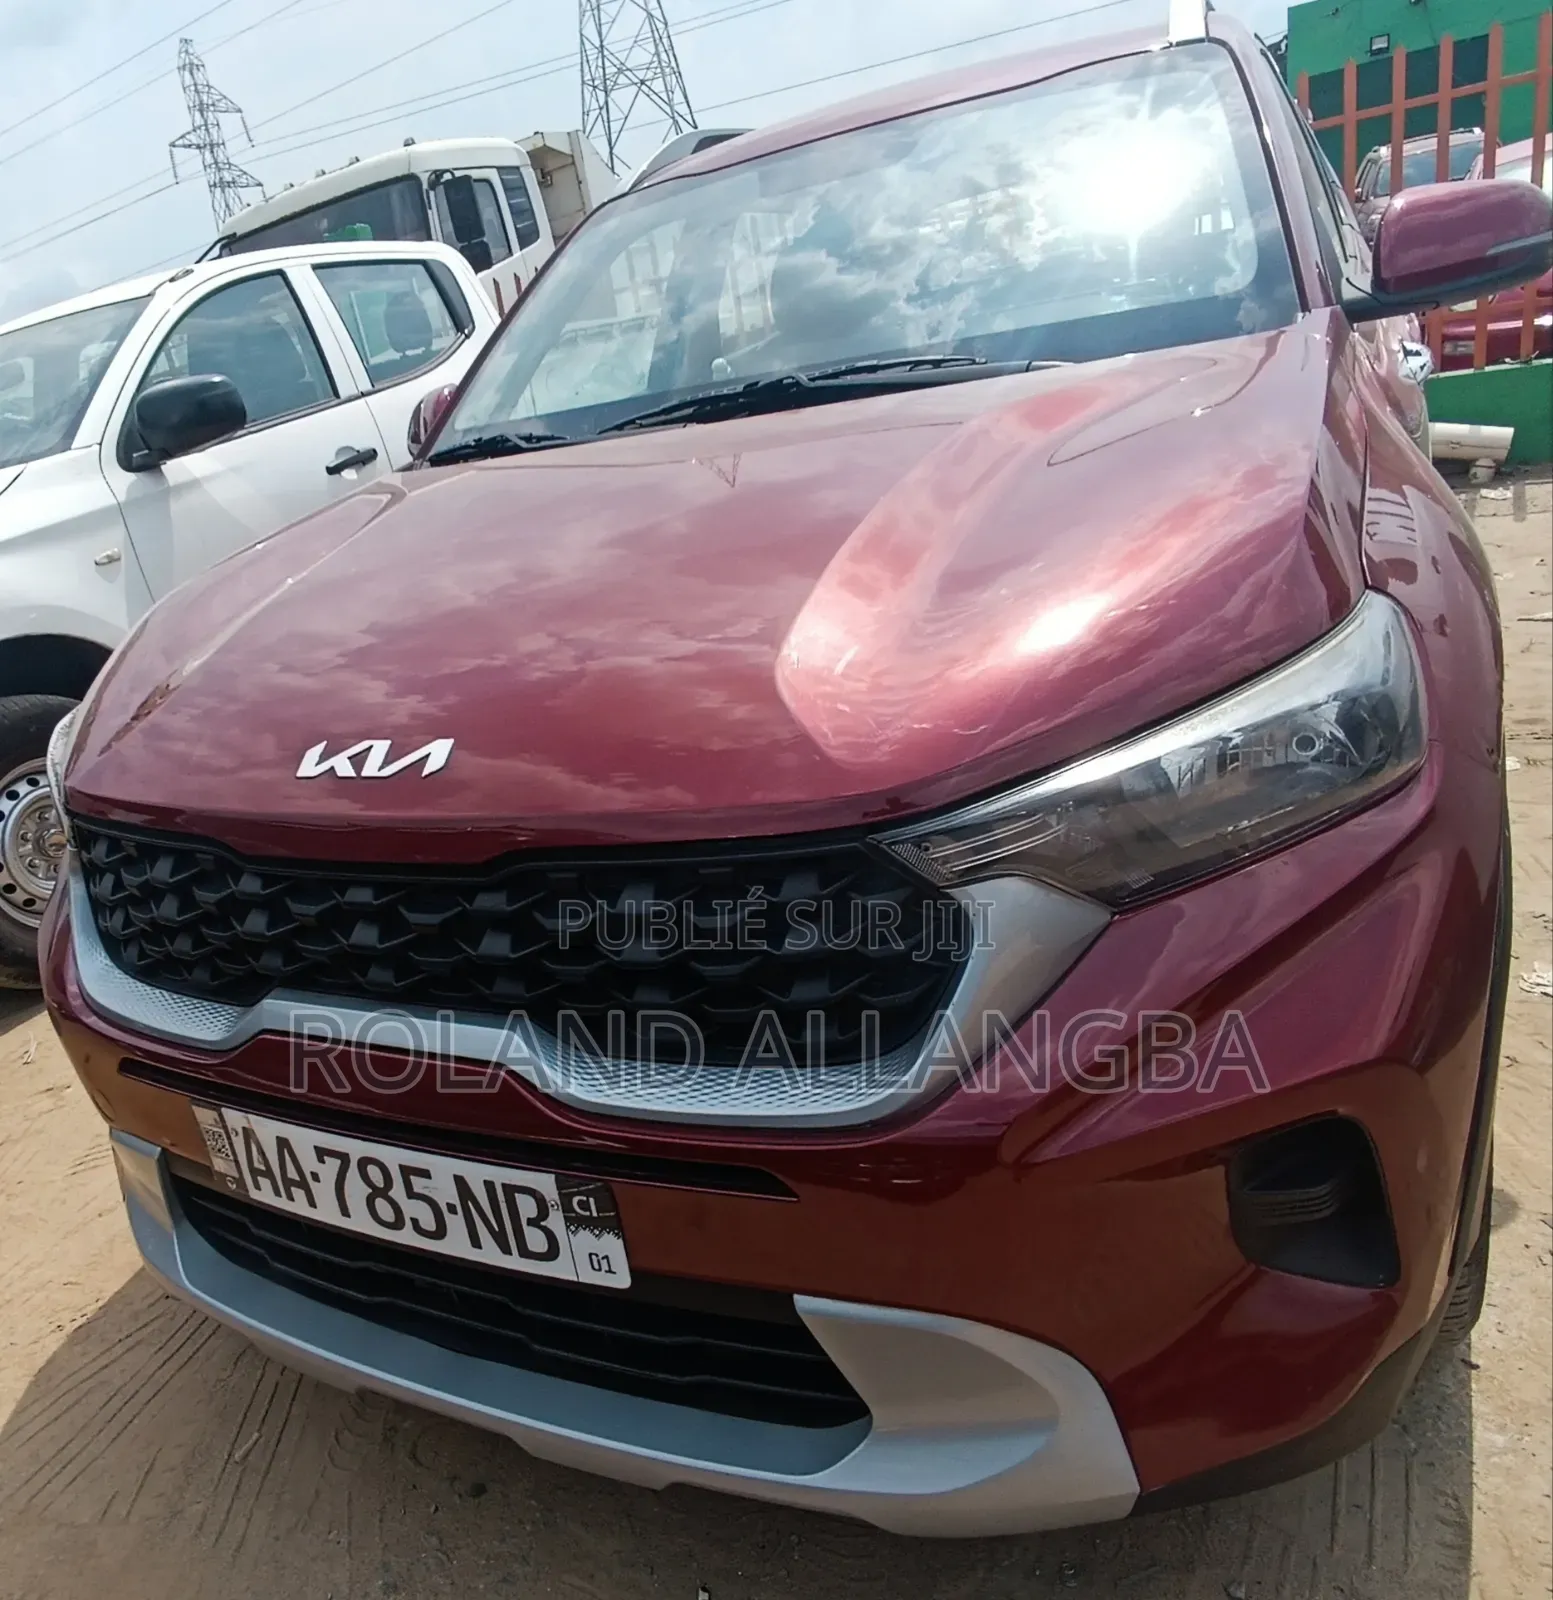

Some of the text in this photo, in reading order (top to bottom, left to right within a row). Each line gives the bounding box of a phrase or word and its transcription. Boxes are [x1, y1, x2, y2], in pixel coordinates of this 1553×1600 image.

[295, 738, 455, 779] KIA
[572, 1195, 599, 1217] CI
[588, 1252, 617, 1275] 01
